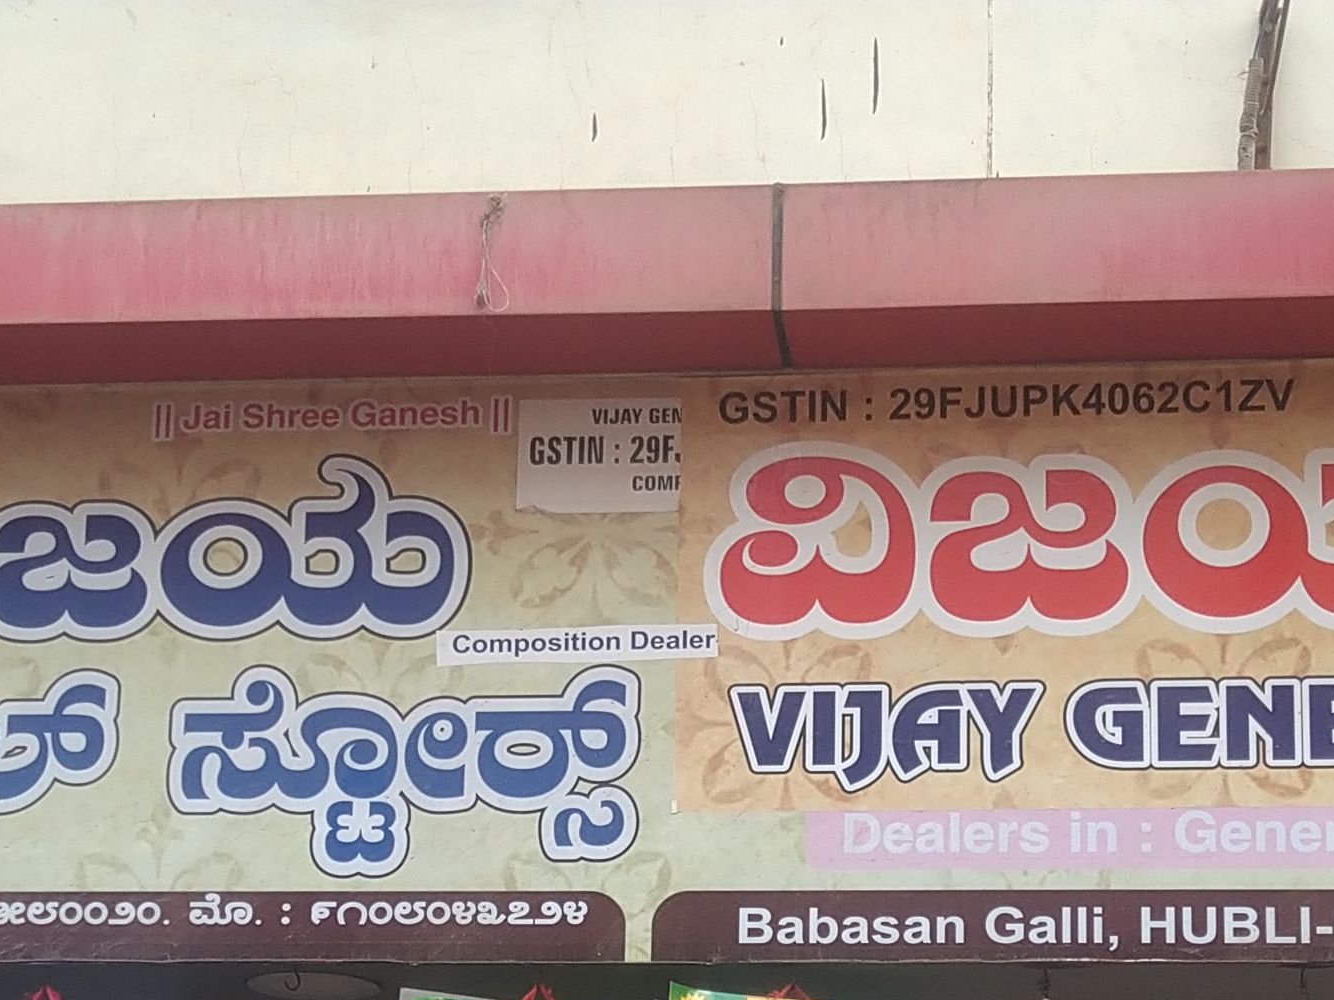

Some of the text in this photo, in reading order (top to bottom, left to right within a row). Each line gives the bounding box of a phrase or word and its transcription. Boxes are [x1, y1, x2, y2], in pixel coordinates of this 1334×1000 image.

[183, 404, 231, 429] Jai
[243, 402, 339, 428] Shree
[351, 400, 480, 427] Ganesh
[592, 408, 642, 424] VIJAY
[718, 388, 848, 424] GSTIN
[889, 379, 1293, 421] 29FJUPK4062C1ZV
[529, 436, 604, 465] GSTIN
[453, 630, 715, 658] Composition Dealer
[729, 681, 1045, 793] VIJAY
[843, 811, 1050, 855] Dealers
[1070, 810, 1118, 854] in
[738, 906, 965, 945] Babasan
[985, 906, 1119, 952] Galli,
